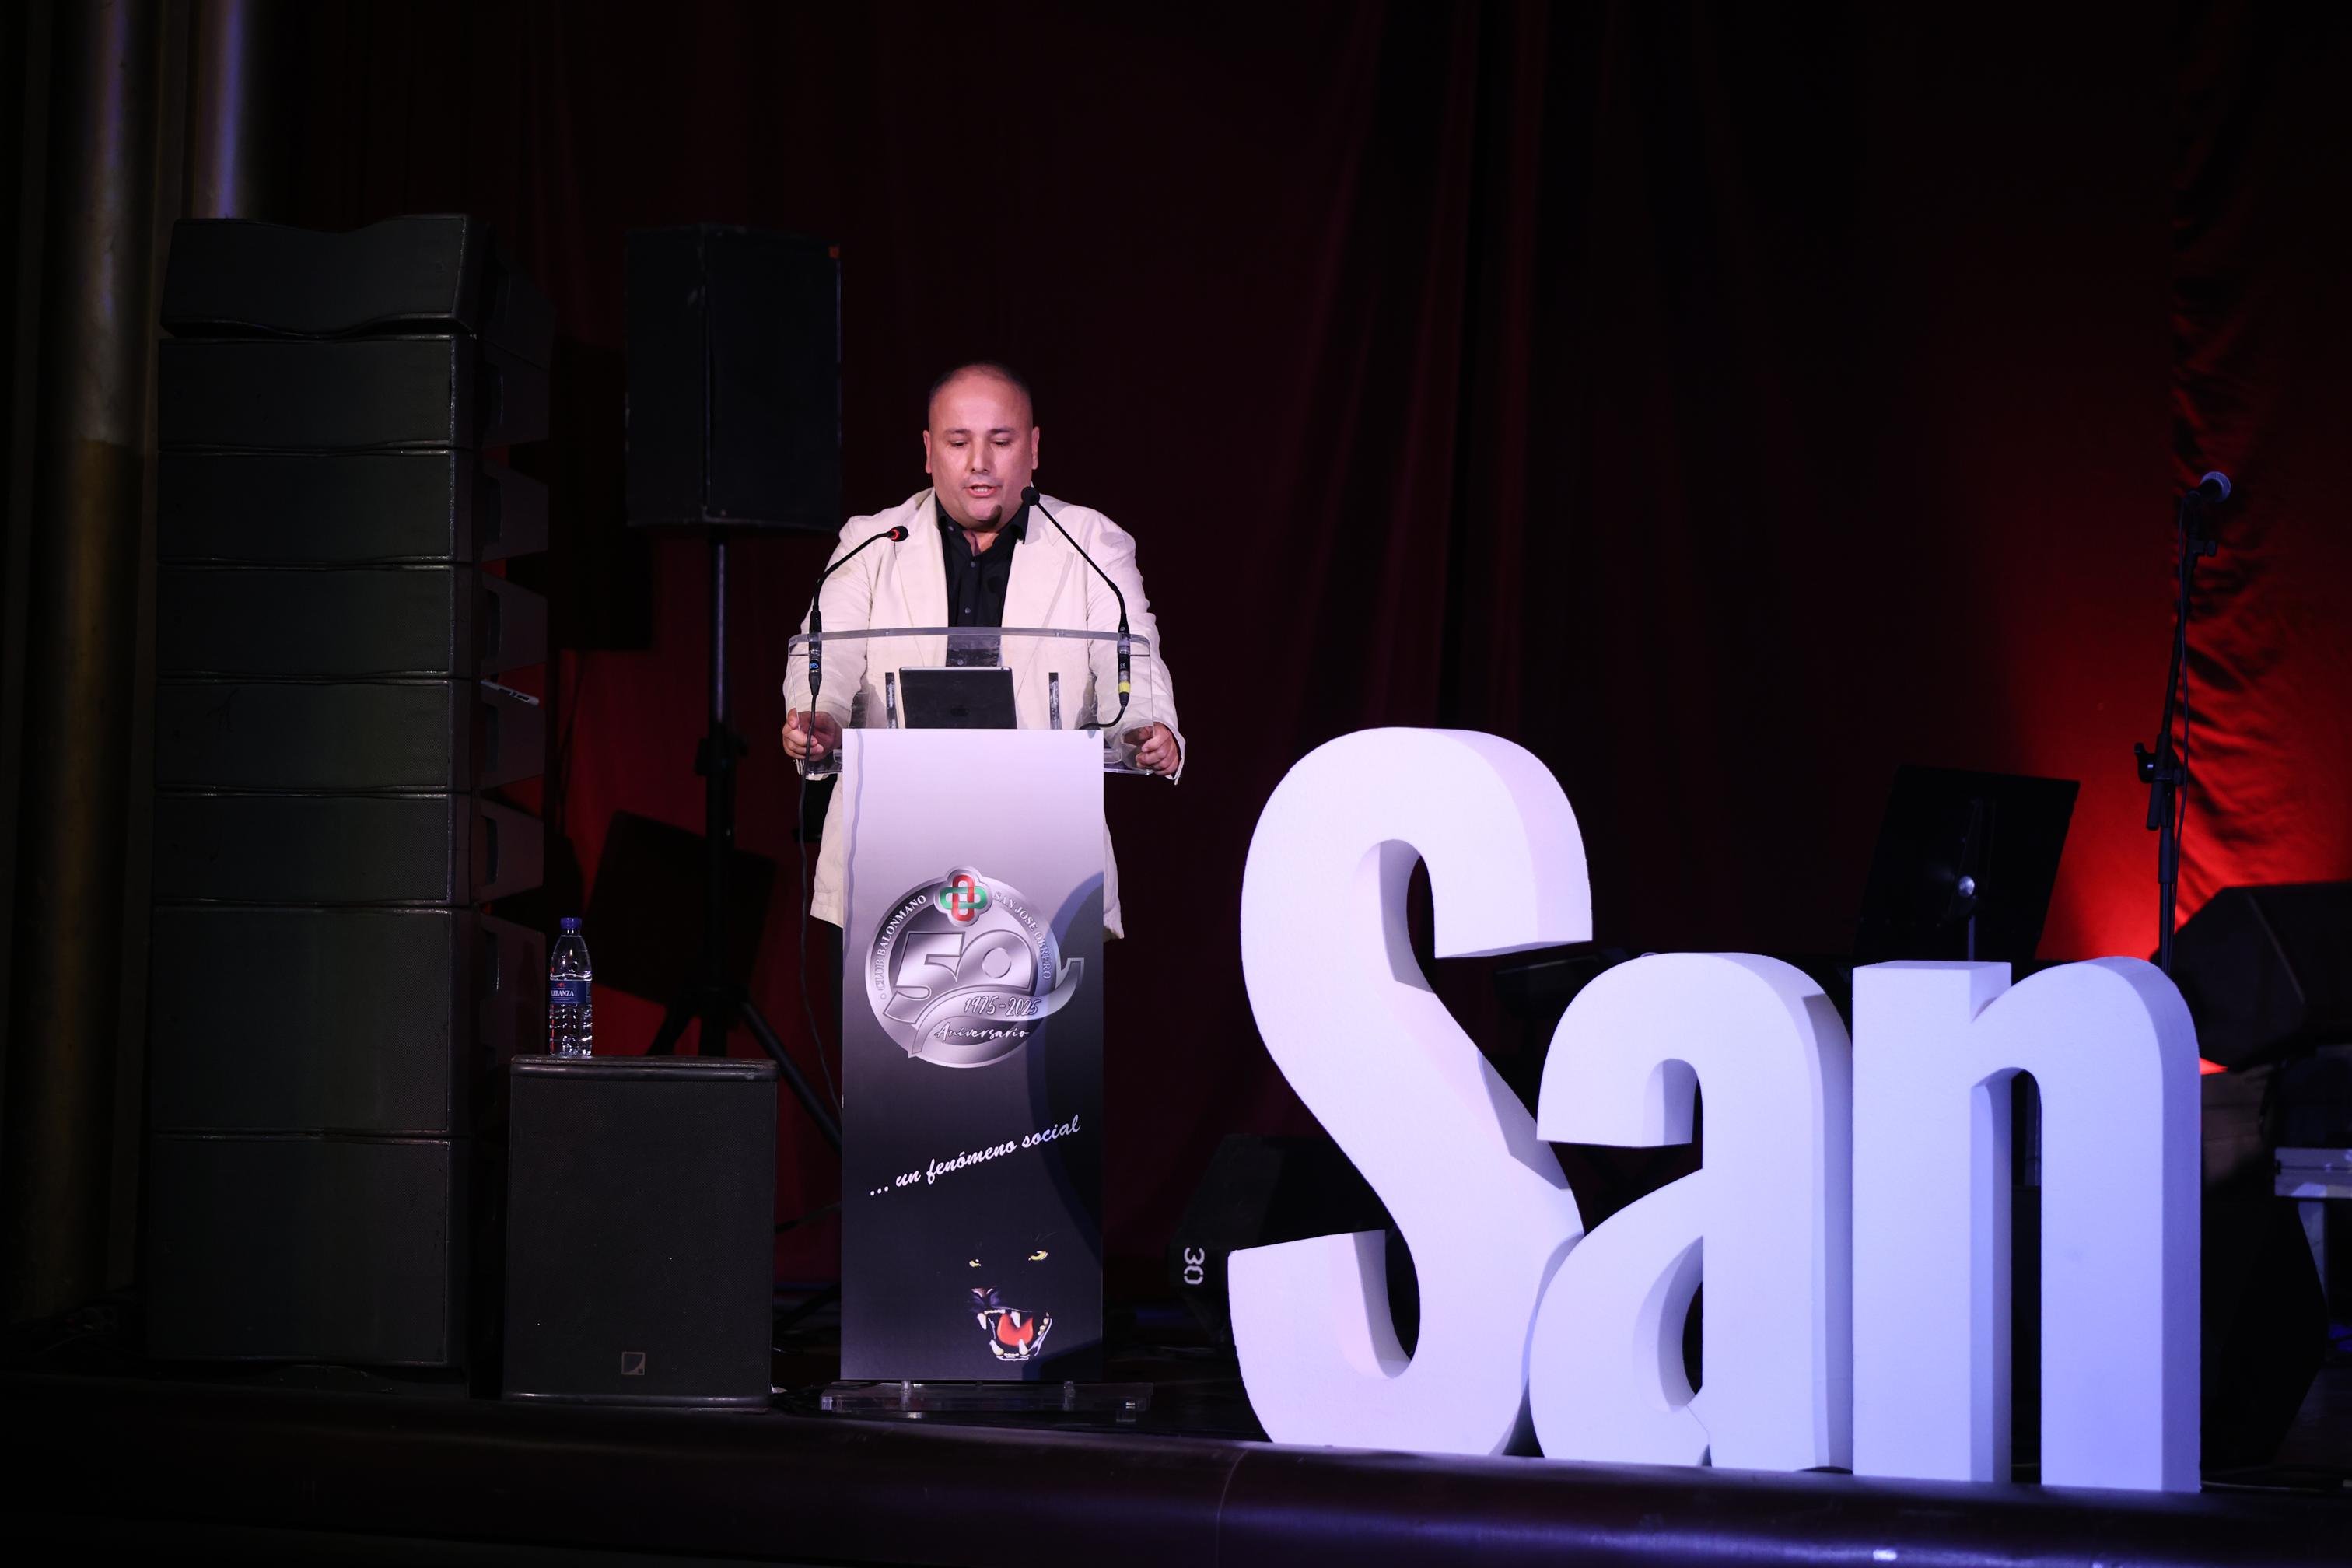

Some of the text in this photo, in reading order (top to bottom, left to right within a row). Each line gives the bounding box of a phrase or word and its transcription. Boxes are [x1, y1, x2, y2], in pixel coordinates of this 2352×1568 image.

[995, 891, 1016, 909] SAN
[877, 895, 926, 956] BALONMANO
[875, 958, 885, 991] CLUB
[883, 929, 1036, 1024] 50
[1034, 931, 1052, 979] OBRERO
[964, 995, 1041, 1017] 1975-2025
[933, 1021, 1030, 1041] Aniversario
[1227, 726, 2202, 1492] San
[895, 1170, 921, 1187] un
[926, 1140, 1017, 1185] fenómeno
[1021, 1114, 1081, 1148] social
[1184, 1247, 1206, 1285] 30
